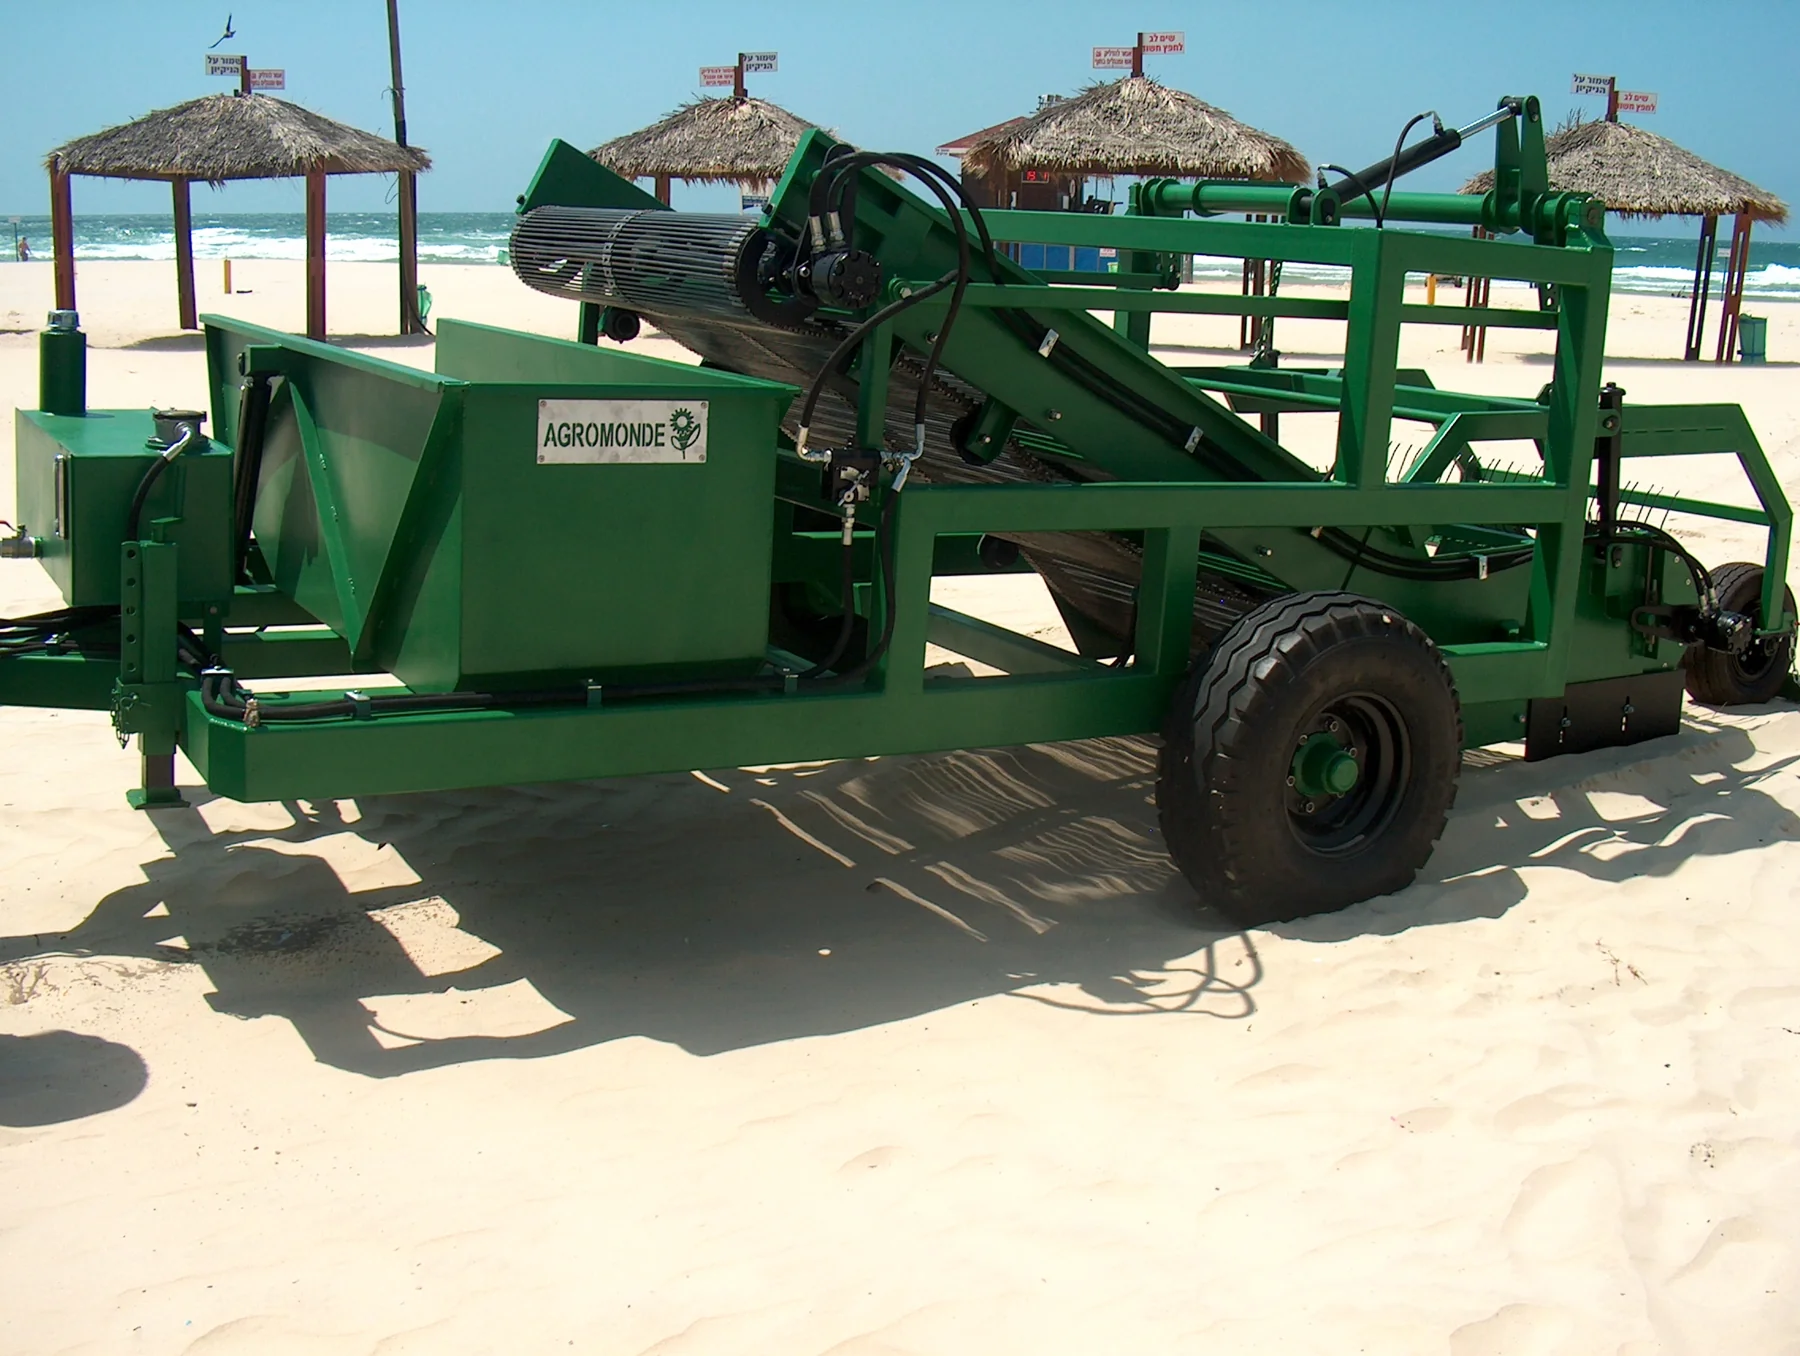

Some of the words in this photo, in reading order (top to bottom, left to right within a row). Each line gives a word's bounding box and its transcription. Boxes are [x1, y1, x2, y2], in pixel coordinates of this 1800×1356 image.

[1149, 33, 1158, 42] לב
[1163, 43, 1183, 54] לחפץ
[208, 56, 219, 64] על
[755, 54, 776, 62] שמור
[211, 66, 239, 75] הניקיון
[745, 63, 773, 72] הניקיון
[1574, 74, 1585, 83] על
[1587, 77, 1610, 86] שמור
[1576, 84, 1606, 94] הניקיון
[1624, 93, 1632, 101] לב
[1636, 103, 1655, 113] לחפץ
[543, 422, 665, 448] AGROMONDE
